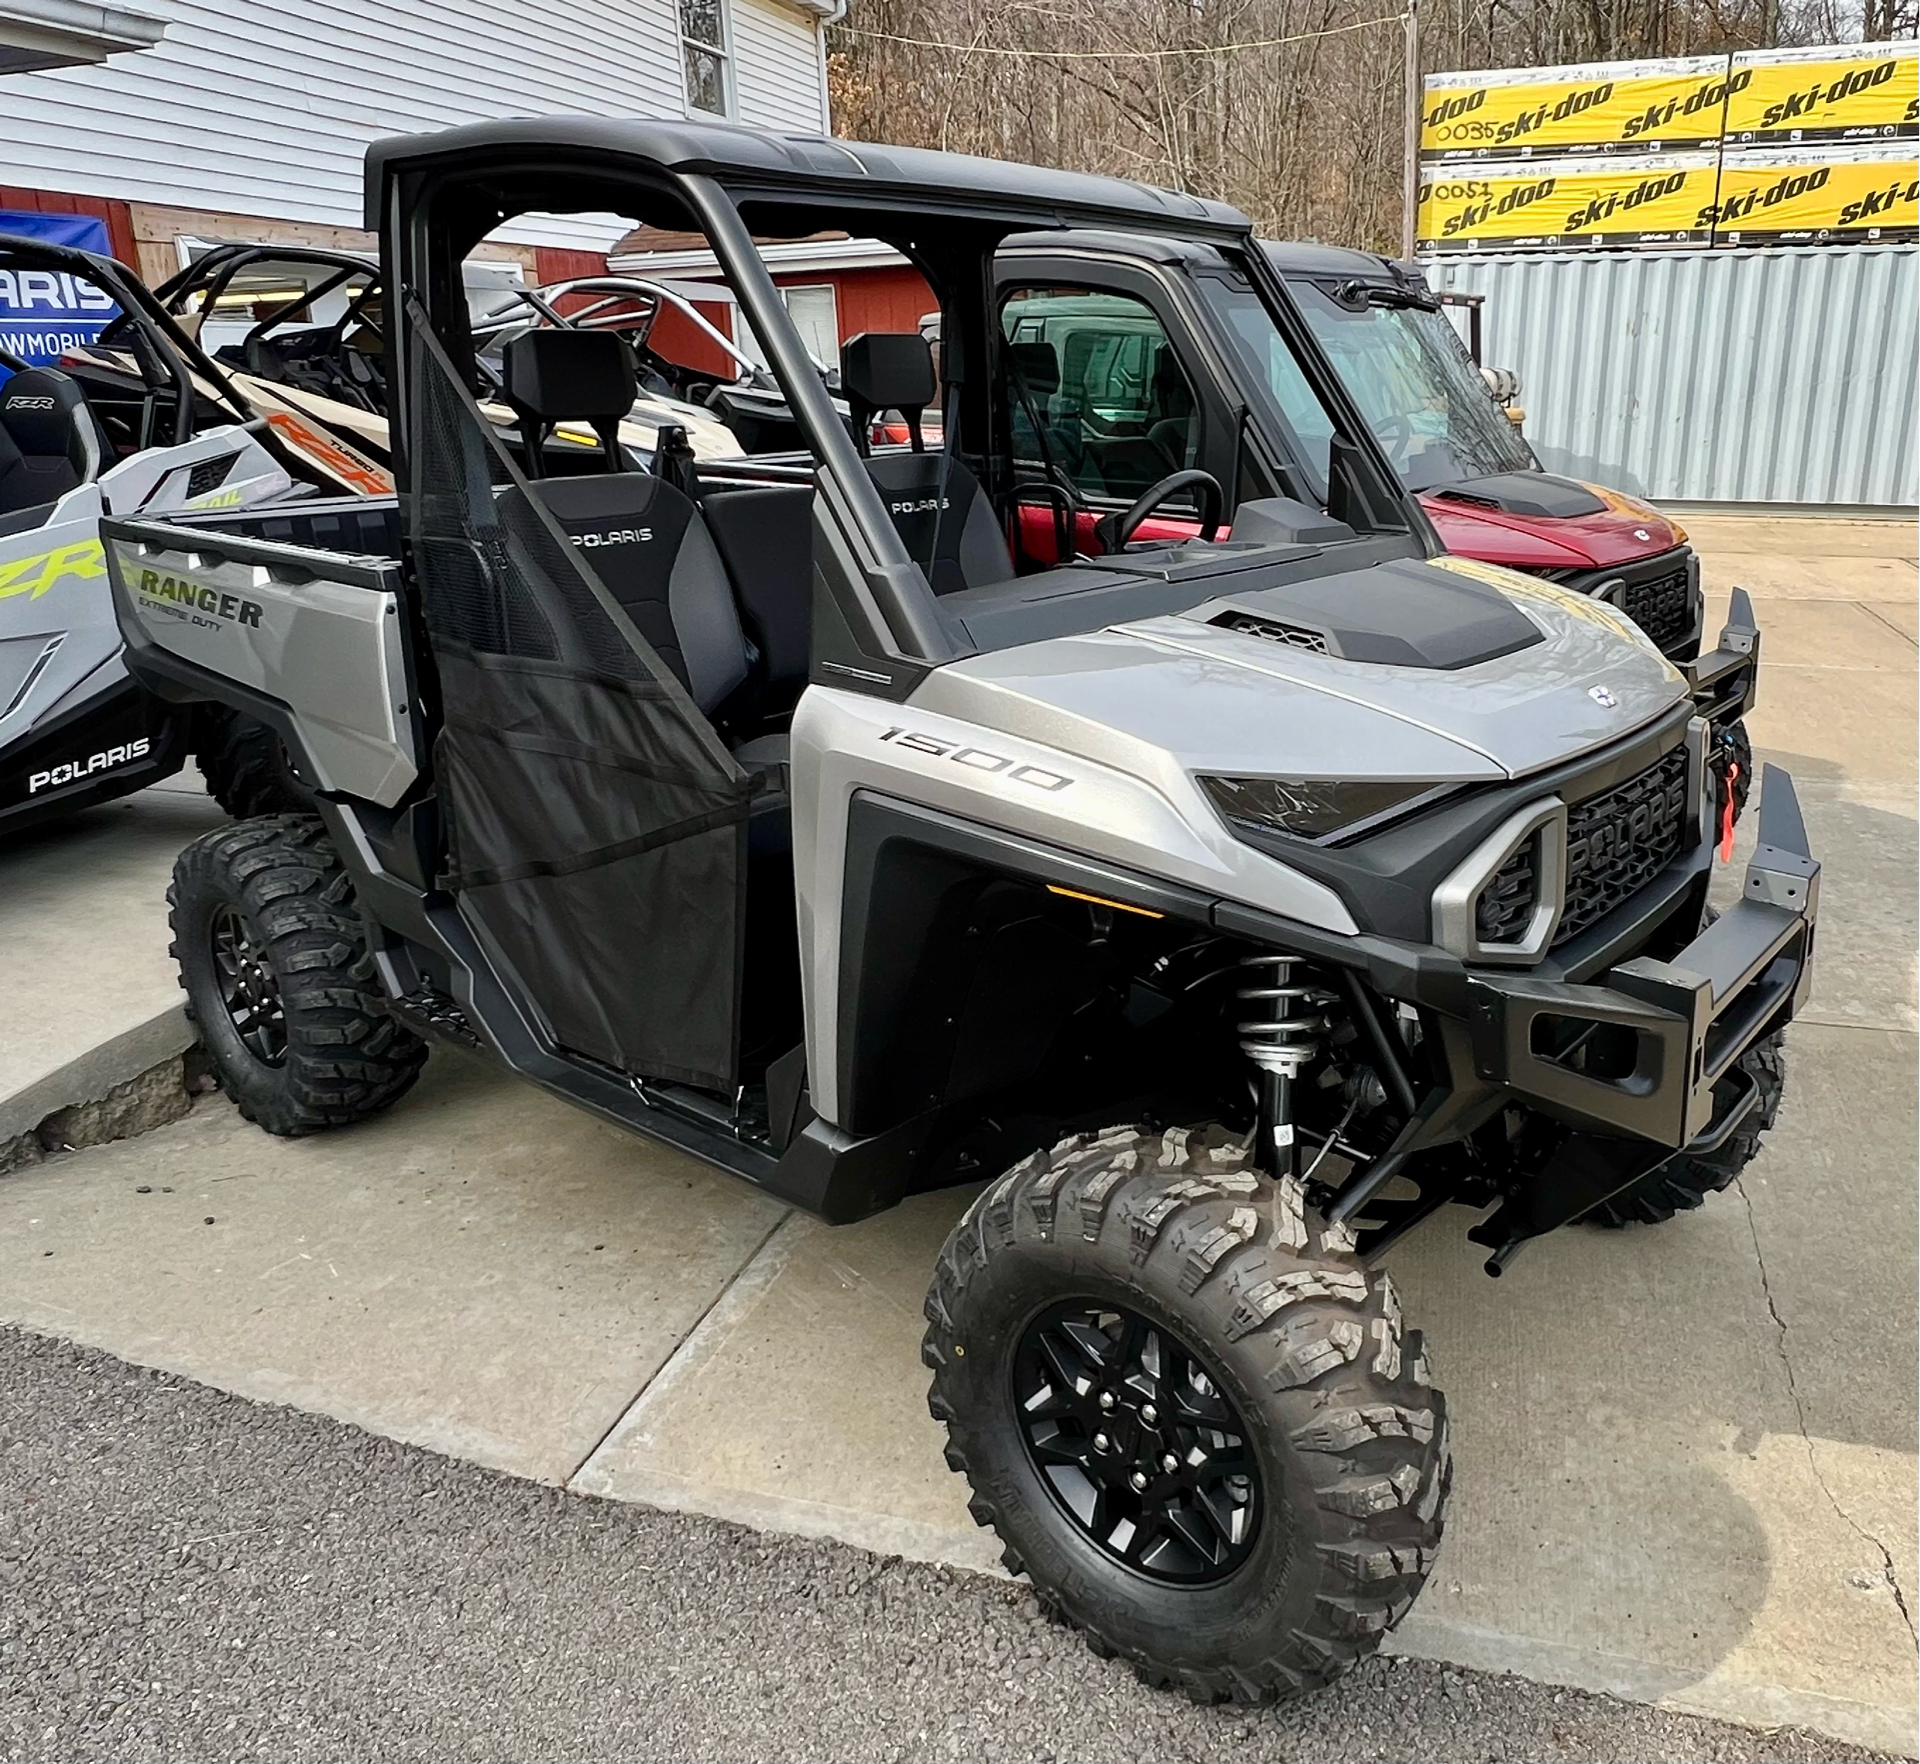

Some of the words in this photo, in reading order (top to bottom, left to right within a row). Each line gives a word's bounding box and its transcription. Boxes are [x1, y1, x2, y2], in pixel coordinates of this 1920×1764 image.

[1495, 83, 1614, 144] ski-doo
[1760, 61, 1898, 128] ski-doo
[1442, 178, 1557, 236] ski-doo
[1564, 171, 1687, 232] ski-doo
[1693, 168, 1831, 228] ski-doo
[329, 439, 375, 473] TURBO
[138, 596, 189, 621] EXTREME
[191, 615, 223, 633] DUTY
[140, 569, 264, 629] RANGER
[29, 737, 151, 794] POLARIS
[878, 726, 1076, 792] 1500
